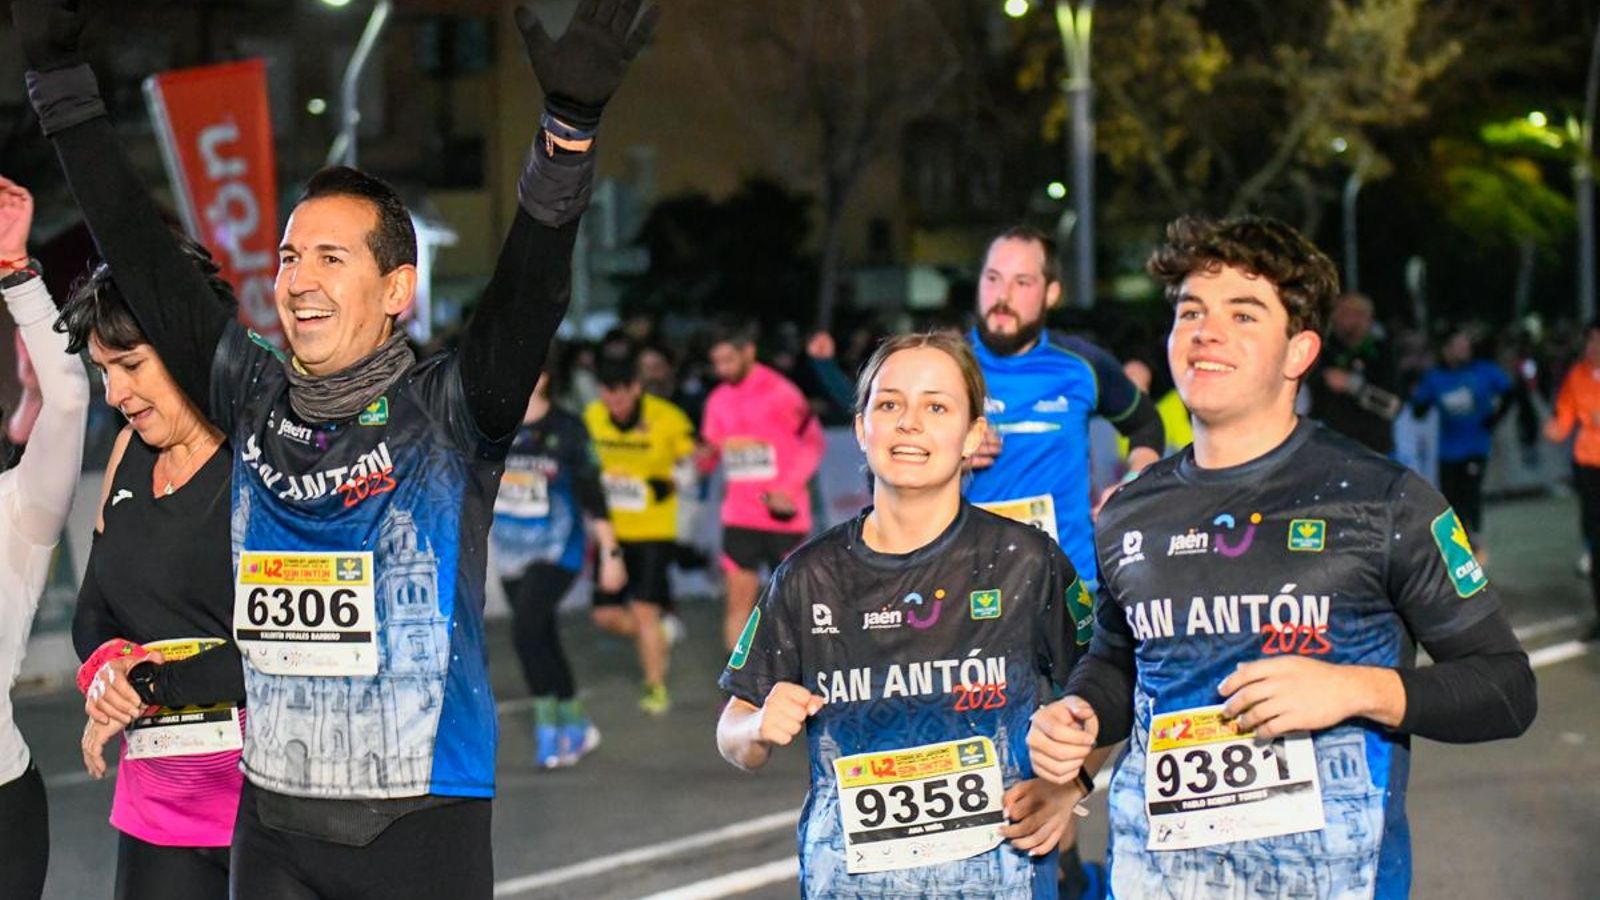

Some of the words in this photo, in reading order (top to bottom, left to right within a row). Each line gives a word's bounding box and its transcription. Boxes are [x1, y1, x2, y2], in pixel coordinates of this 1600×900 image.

[337, 466, 397, 507] 2025
[1167, 528, 1209, 556] jaén
[264, 559, 283, 578] 42
[247, 587, 360, 628] 6306
[862, 606, 902, 630] jaén
[1186, 583, 1330, 636] ANTÓN
[1261, 623, 1333, 655] 2025
[817, 667, 871, 705] SAN
[883, 649, 1007, 699] ANTÓN
[952, 682, 1008, 712] 2025
[869, 758, 897, 778] 42
[1156, 736, 1290, 798] 9381
[855, 774, 989, 828] 9358
